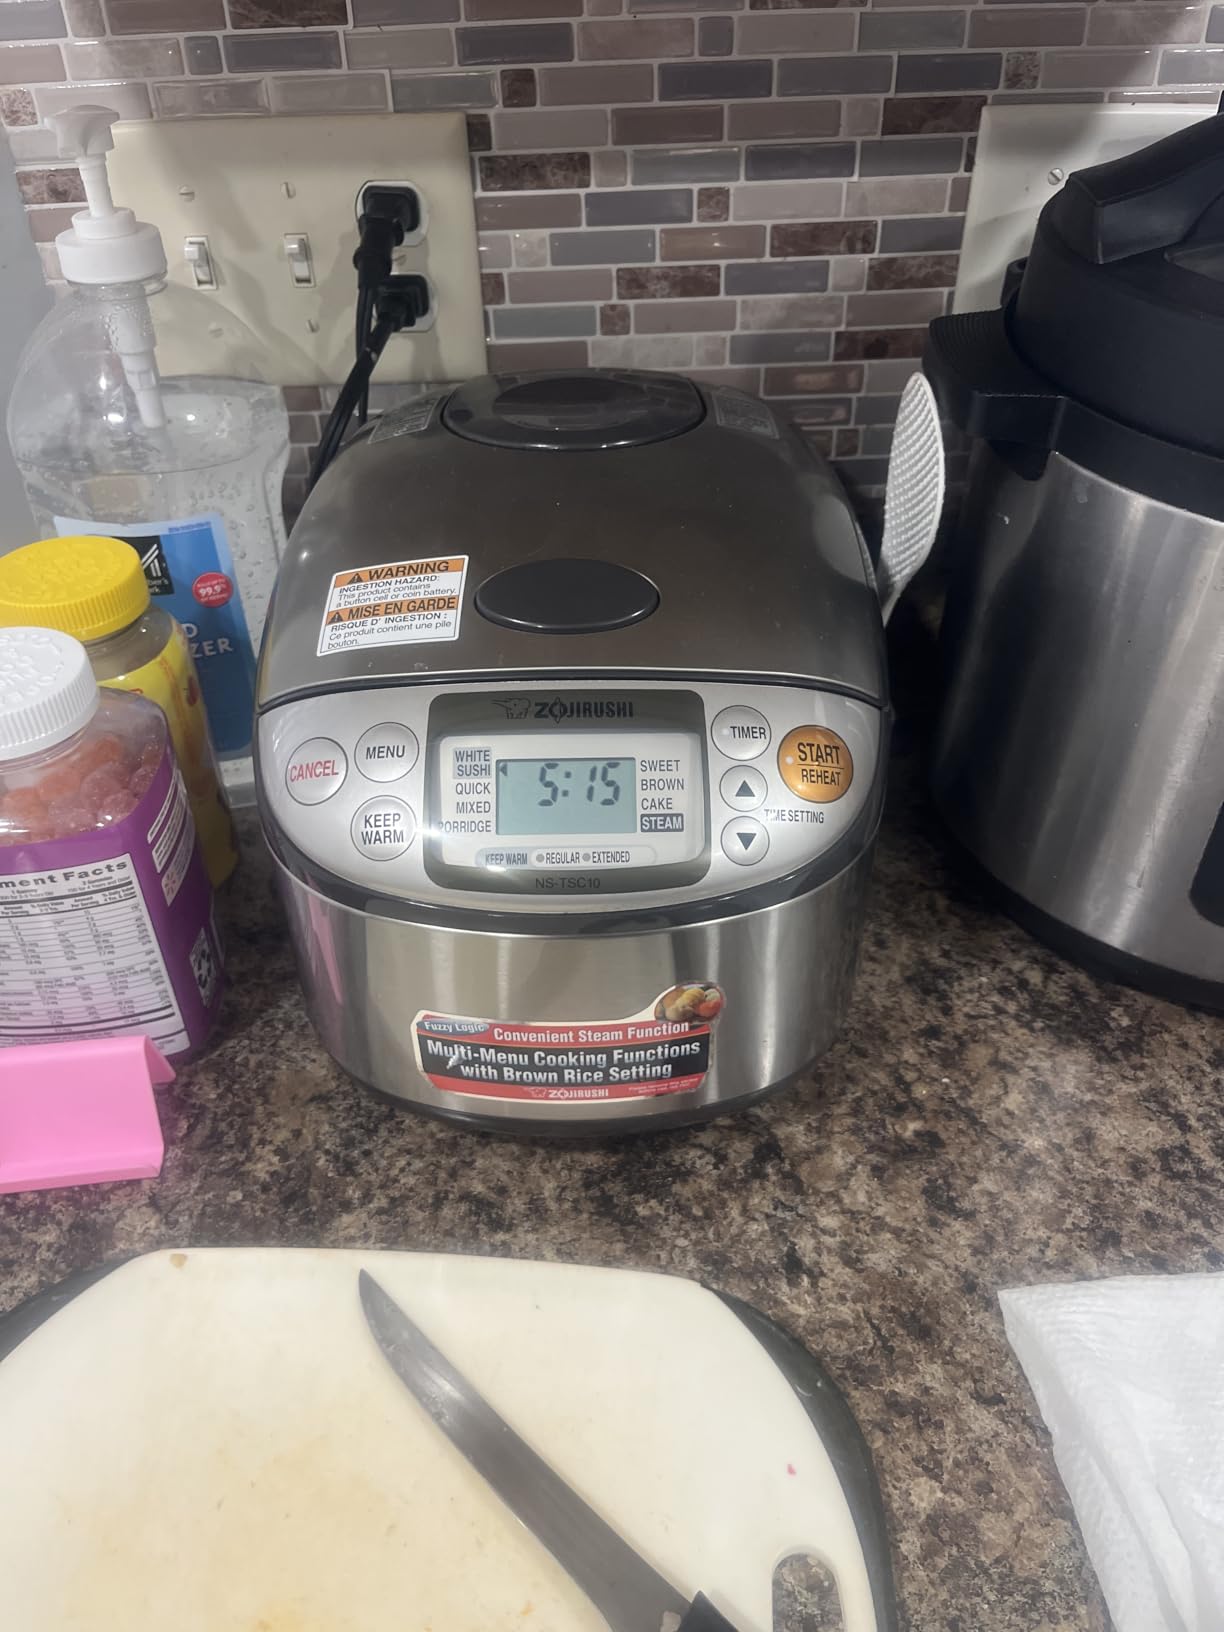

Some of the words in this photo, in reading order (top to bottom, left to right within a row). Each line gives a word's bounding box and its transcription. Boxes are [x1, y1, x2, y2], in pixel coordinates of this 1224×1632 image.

[368, 561, 449, 580] WARNING
[338, 591, 356, 601] This
[358, 586, 390, 599] product
[393, 582, 431, 593] contains
[339, 580, 392, 594] INGESTION
[395, 575, 440, 586] HAZARD:
[343, 597, 371, 608] button
[373, 593, 389, 603] cell
[402, 590, 422, 599] coin
[423, 588, 457, 598] battery.
[347, 605, 380, 620] MISE
[384, 602, 403, 616] EN
[407, 597, 456, 613] GARDE
[331, 620, 368, 633] RISQUE
[384, 612, 441, 624] INGESTION
[329, 632, 342, 641] Ce
[343, 628, 375, 640] produit
[376, 622, 414, 634] contient
[415, 622, 433, 630] une
[435, 620, 452, 631] pile
[328, 638, 360, 650] bouton.
[534, 698, 634, 723] ZOJIRUSHI
[730, 726, 767, 740] TIMER
[365, 745, 406, 760] MENU
[455, 750, 490, 762] WHITE
[797, 742, 840, 765] START
[289, 759, 339, 782] CANCEL
[457, 763, 491, 777] SUSHI
[640, 759, 680, 773] SWEET
[538, 761, 621, 806] 5:15
[641, 777, 685, 791] BROWN
[801, 768, 841, 786] REHEAT
[455, 782, 491, 795] QUICK
[456, 801, 491, 814] MIXED
[641, 797, 673, 810] CAKE
[364, 813, 401, 829] KEEP
[641, 816, 683, 830] STEAM
[788, 809, 824, 824] SETTING
[361, 829, 404, 846] WARM
[485, 853, 504, 866] KEEP
[505, 852, 528, 865] WARM
[545, 851, 580, 865] REGULAR
[592, 850, 630, 864] EXTENDED
[63, 861, 127, 881] Facts
[535, 877, 600, 889] NS-TSC10
[424, 1021, 453, 1033] Fuzzy
[455, 1023, 485, 1033] Logic
[493, 1028, 574, 1043] Convenient
[578, 1029, 623, 1043] Steam
[627, 1021, 689, 1039] Function
[427, 1039, 529, 1066] Multi-Menu
[534, 1051, 607, 1068] Cooking
[613, 1041, 701, 1065] Functions
[460, 1063, 498, 1080] with
[503, 1066, 559, 1084] Brown
[563, 1068, 604, 1084] Rice
[609, 1064, 673, 1081] Setting
[548, 1087, 609, 1100] ZOJIRUSHI
